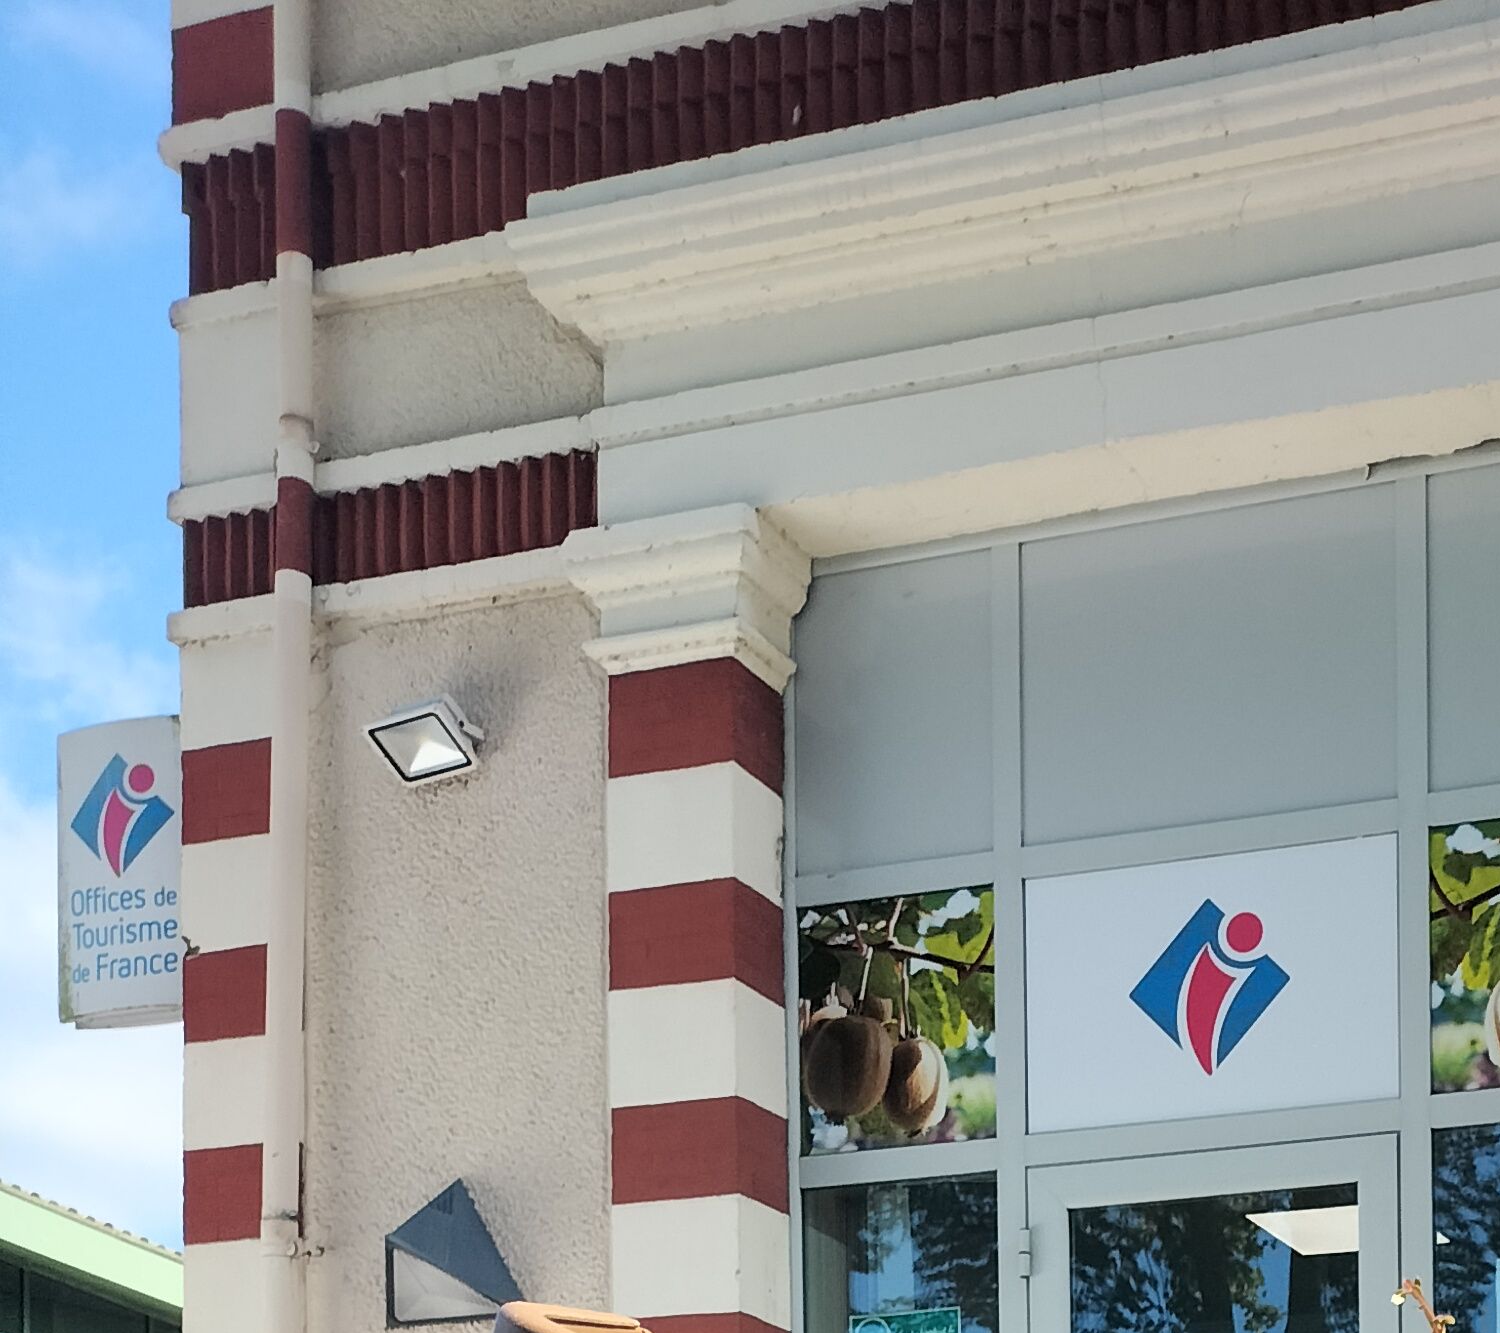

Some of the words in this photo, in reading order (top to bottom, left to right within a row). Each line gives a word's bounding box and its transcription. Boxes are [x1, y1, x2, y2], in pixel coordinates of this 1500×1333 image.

[71, 887, 146, 917] Offices
[154, 887, 178, 907] de
[72, 916, 178, 951] Tourisme
[72, 962, 90, 984] de
[95, 951, 179, 982] France
